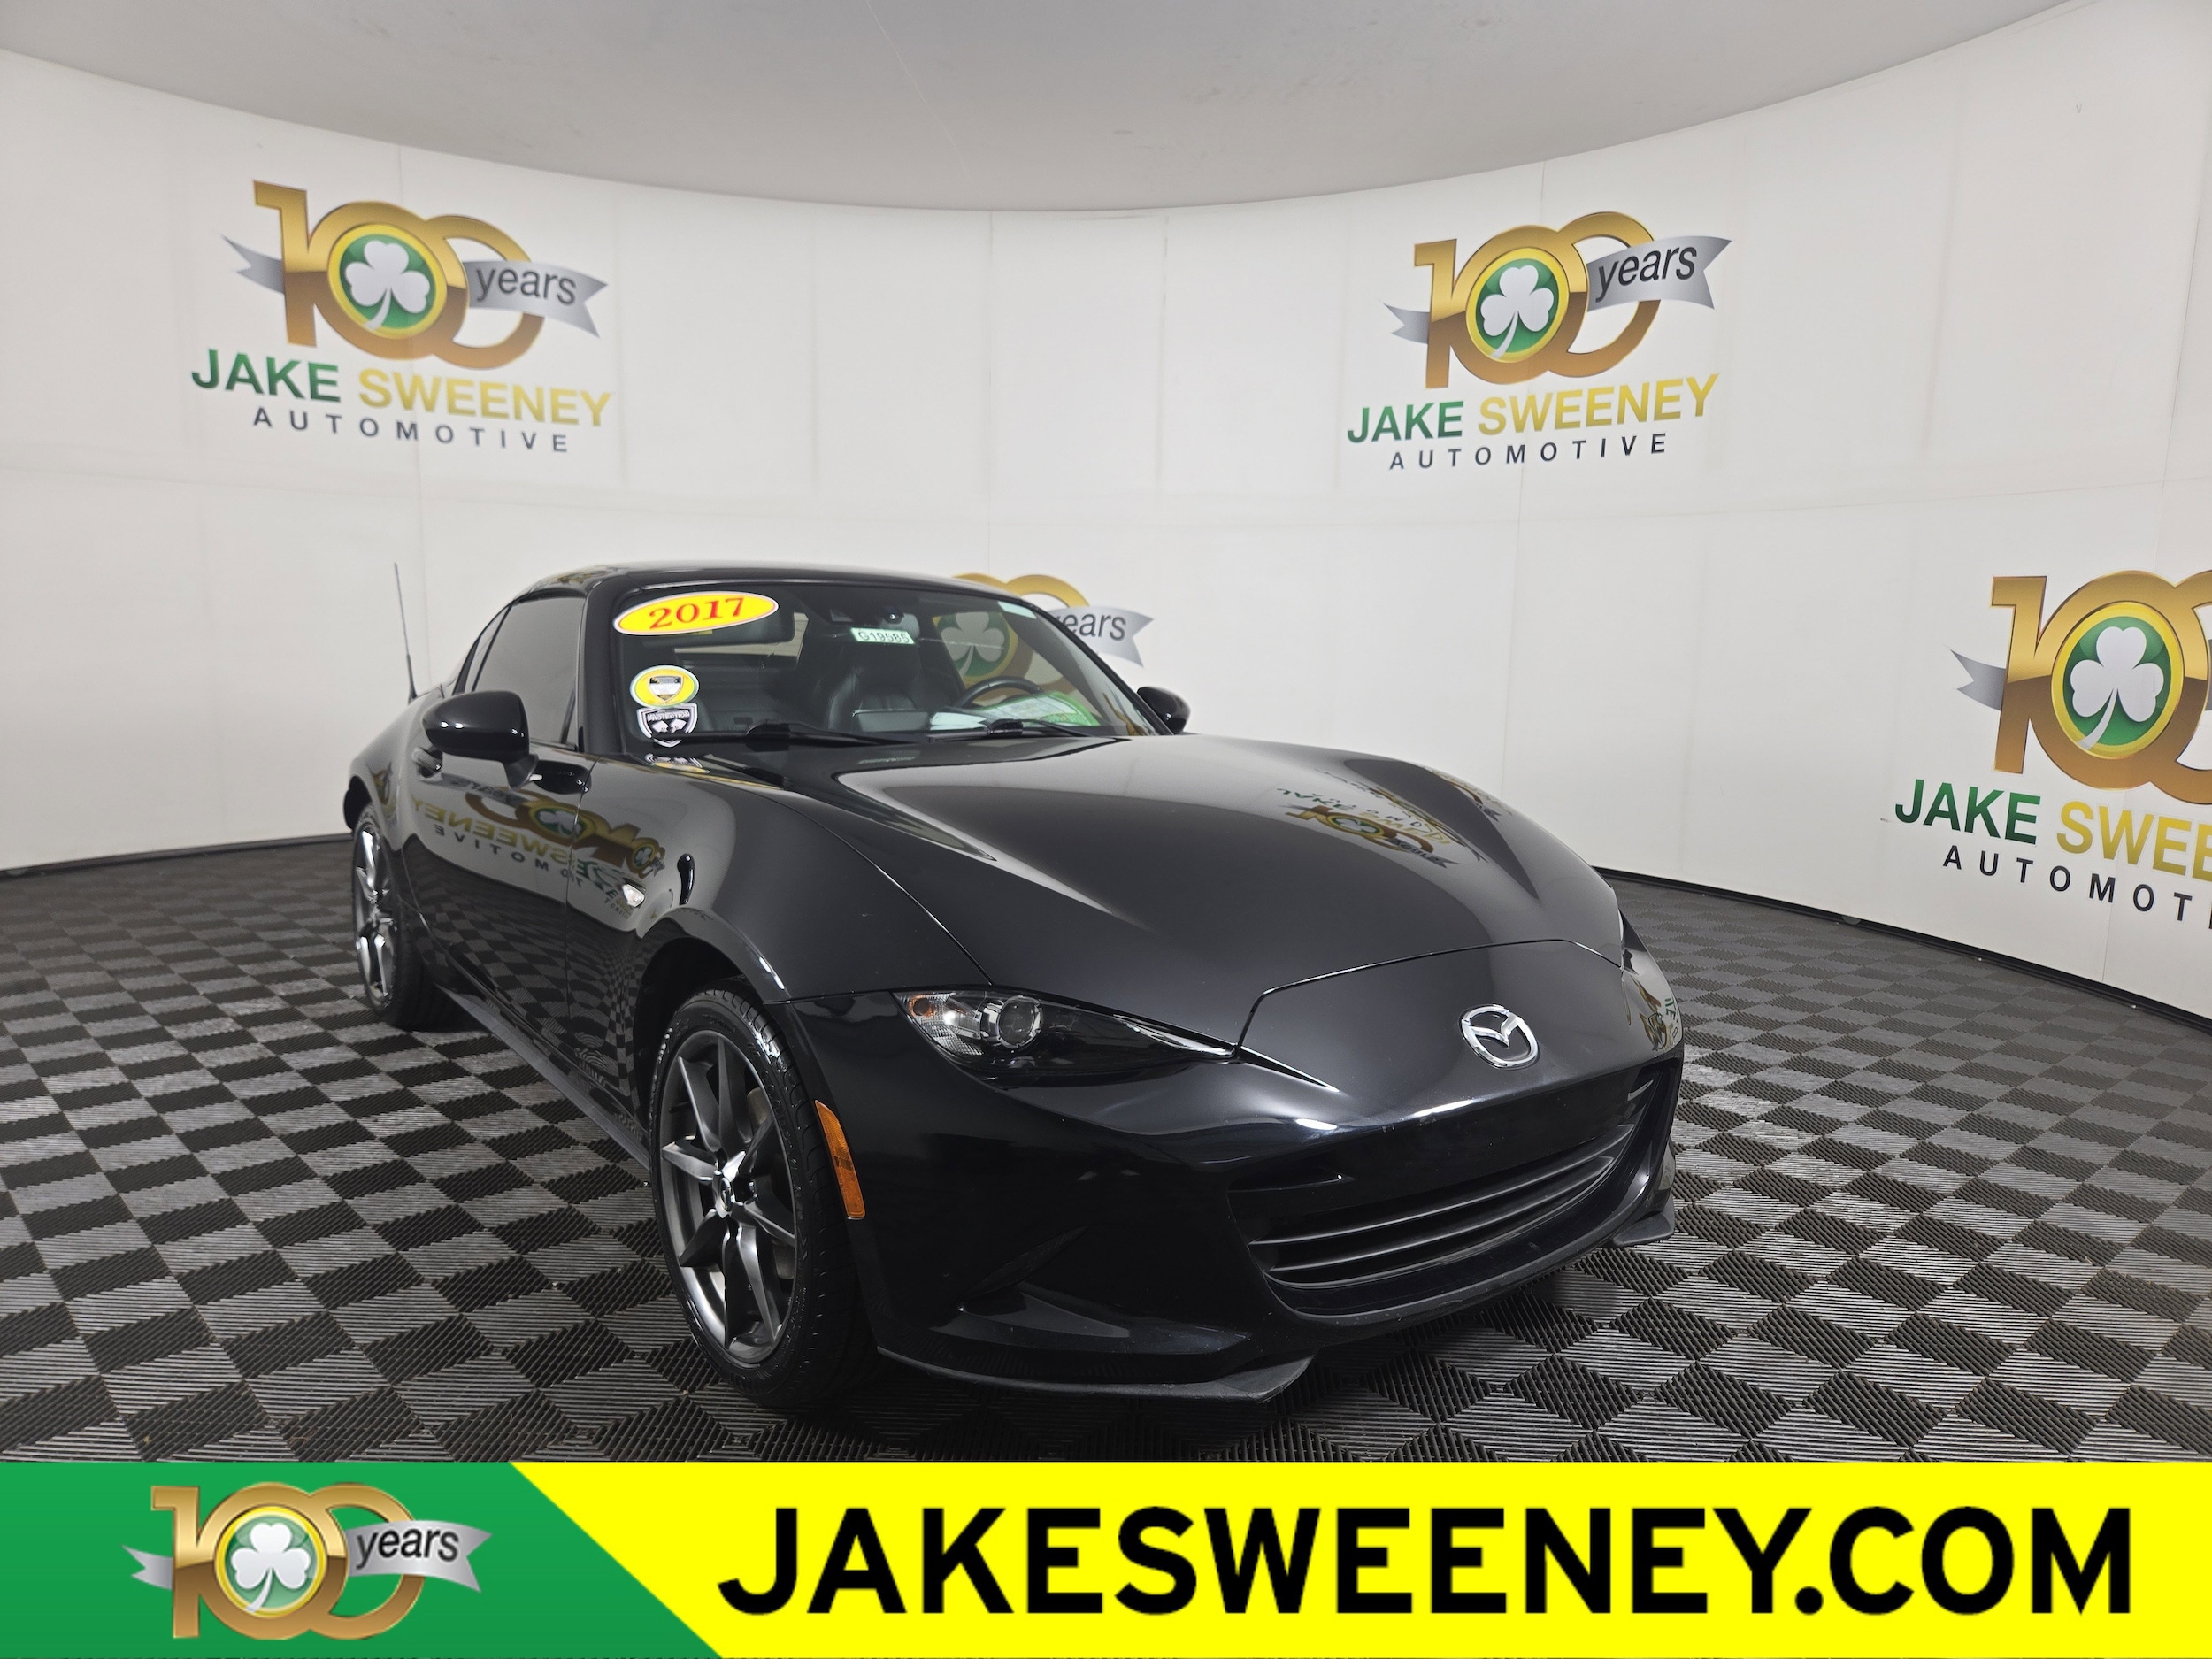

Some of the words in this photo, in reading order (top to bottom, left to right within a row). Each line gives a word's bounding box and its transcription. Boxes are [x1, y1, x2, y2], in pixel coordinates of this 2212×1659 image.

[252, 180, 546, 371] 100
[475, 265, 578, 307] years
[1414, 211, 1661, 389] 100
[1595, 245, 1698, 303] years
[191, 348, 341, 403] JAKE
[358, 368, 611, 428] SWEENEY
[1347, 400, 1464, 444] JAKE
[1478, 373, 1719, 436] SWEENEY
[253, 406, 568, 453] AUTOMOTIVE
[1388, 433, 1667, 471] AUTOMOTIVE
[649, 597, 744, 630] 2017
[1053, 613, 1127, 642] ears
[1894, 778, 2041, 846] JAKE
